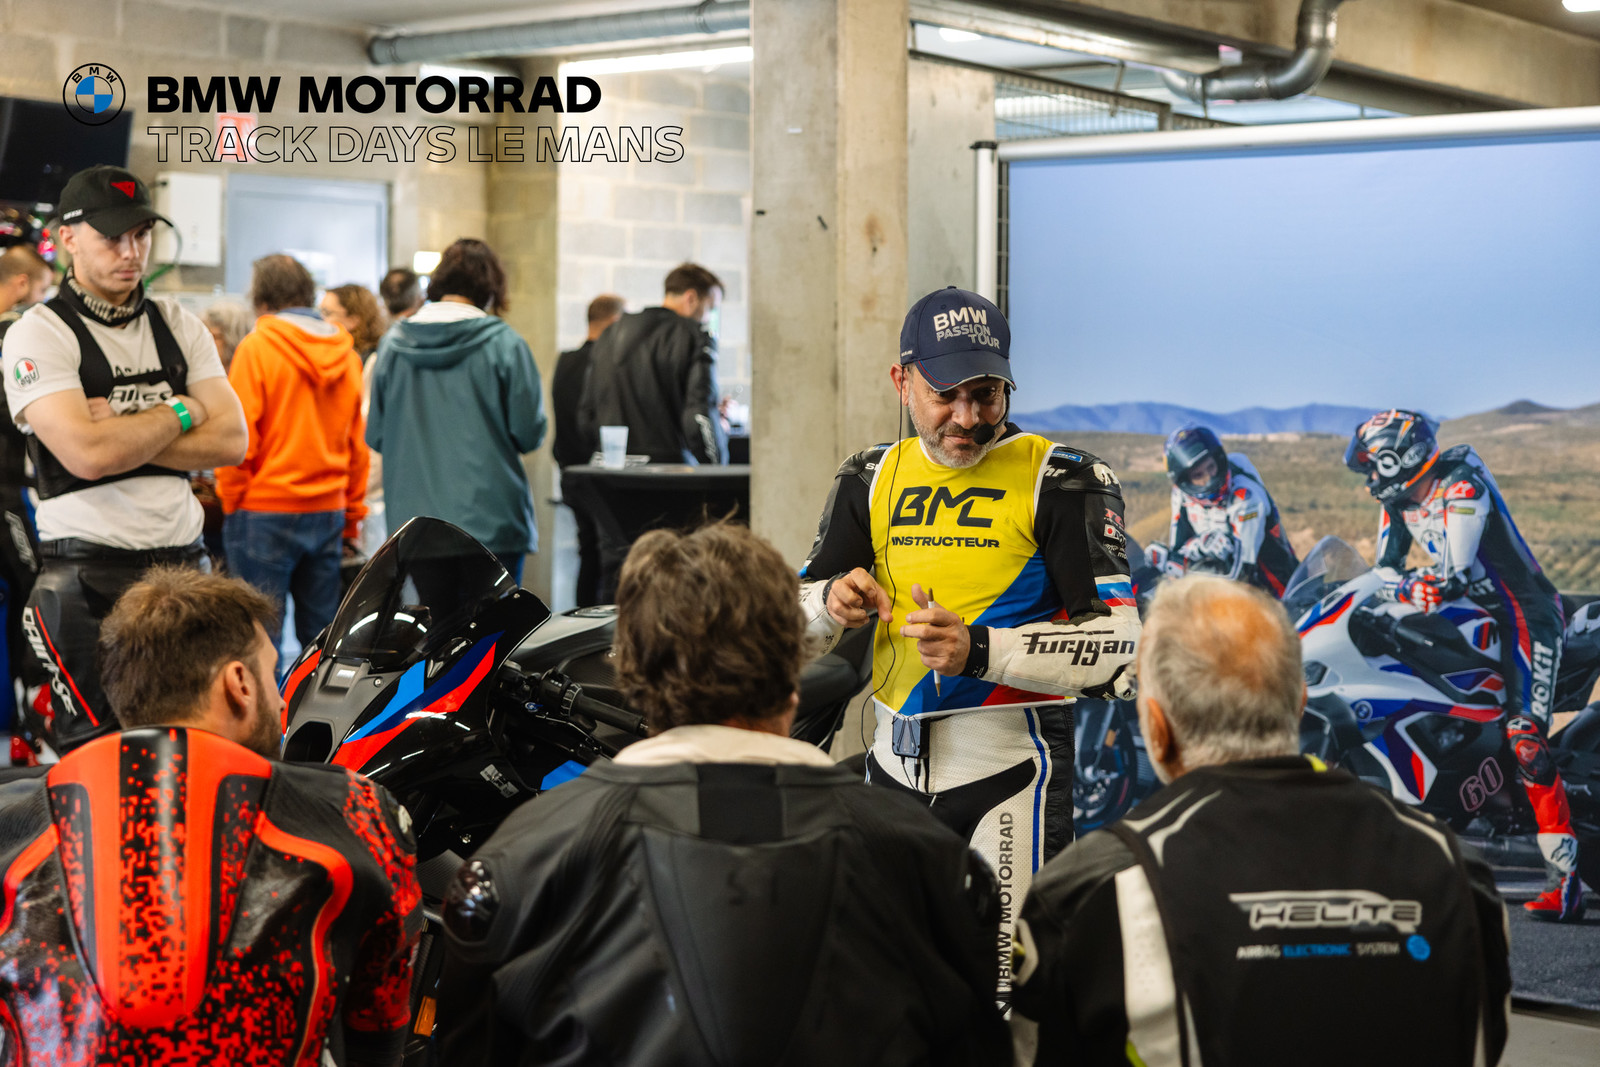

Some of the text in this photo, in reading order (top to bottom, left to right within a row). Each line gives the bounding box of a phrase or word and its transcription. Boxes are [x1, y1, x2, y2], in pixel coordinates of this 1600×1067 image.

[933, 306, 987, 332] BMW
[936, 323, 991, 342] PASSION
[968, 333, 1000, 349] TOUR
[891, 486, 1007, 528] BMC
[891, 536, 1000, 548] INSTRUCTEUR
[1459, 757, 1504, 812] 60
[998, 812, 1014, 980] BMW MOTORRAD
[1251, 901, 1421, 930] HELITE
[1236, 945, 1281, 960] AIRBAG
